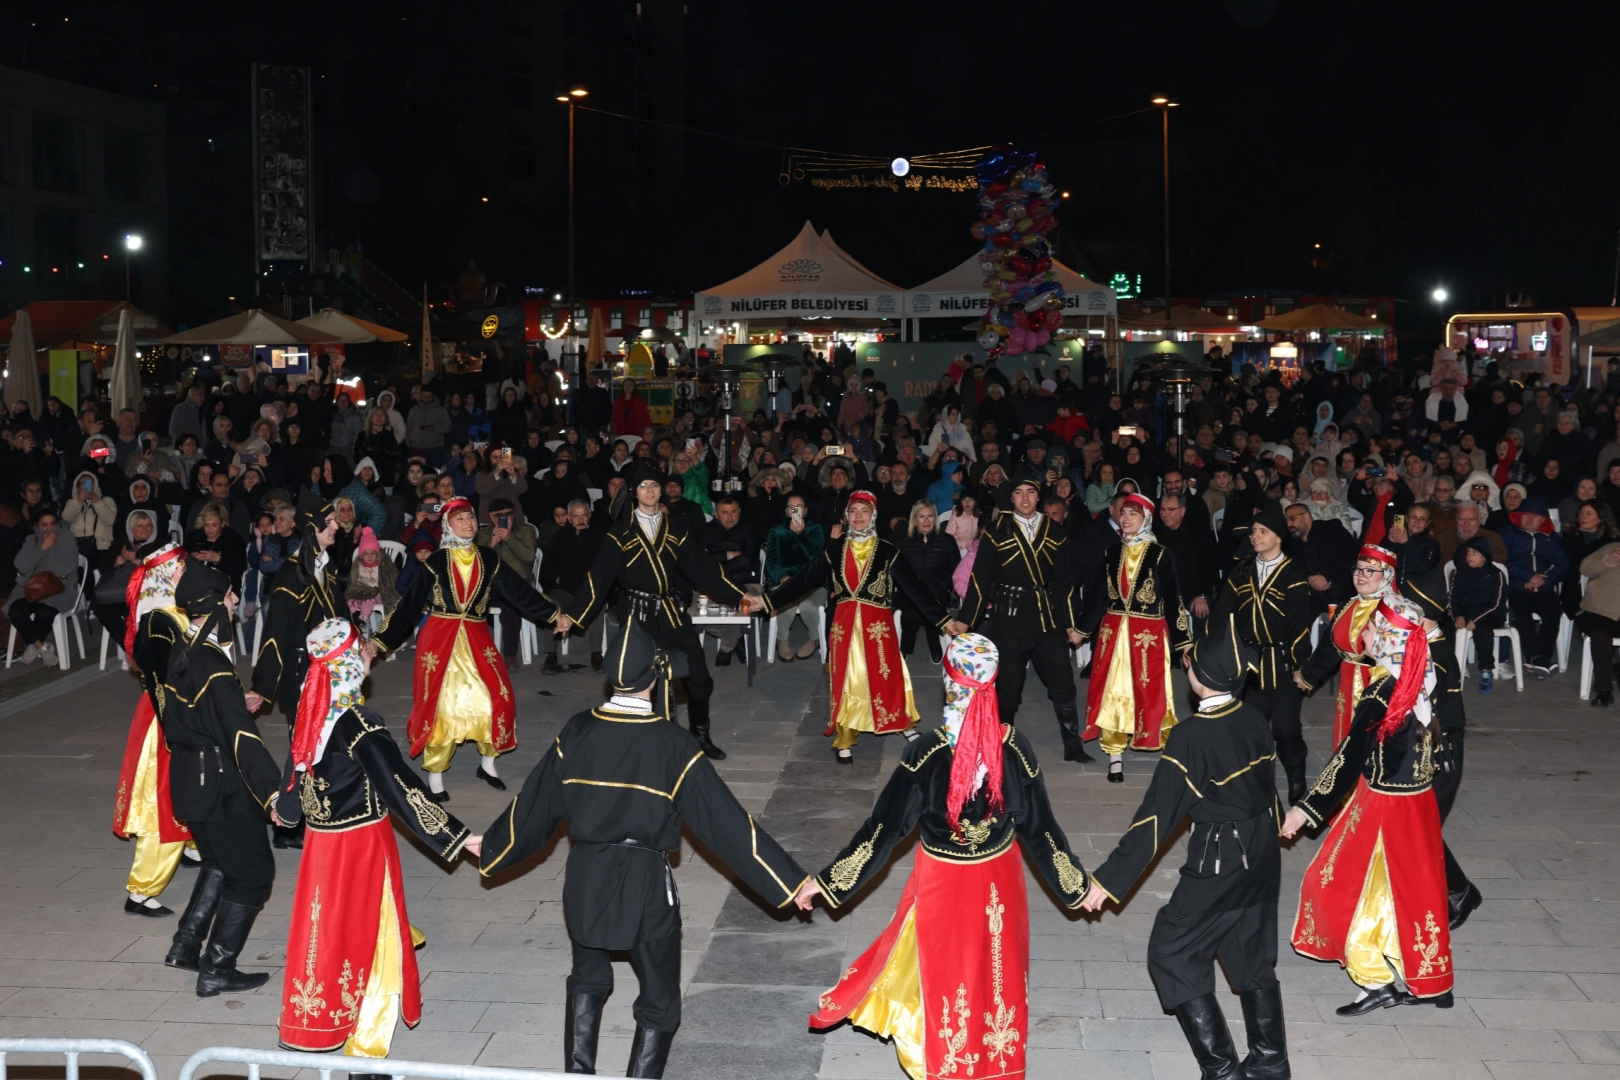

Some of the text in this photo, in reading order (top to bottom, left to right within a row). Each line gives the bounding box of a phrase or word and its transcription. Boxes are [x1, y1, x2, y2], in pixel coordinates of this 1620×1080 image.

[731, 297, 868, 312] NİLÜFER BELEDİYESİ
[904, 380, 937, 398] RAM
